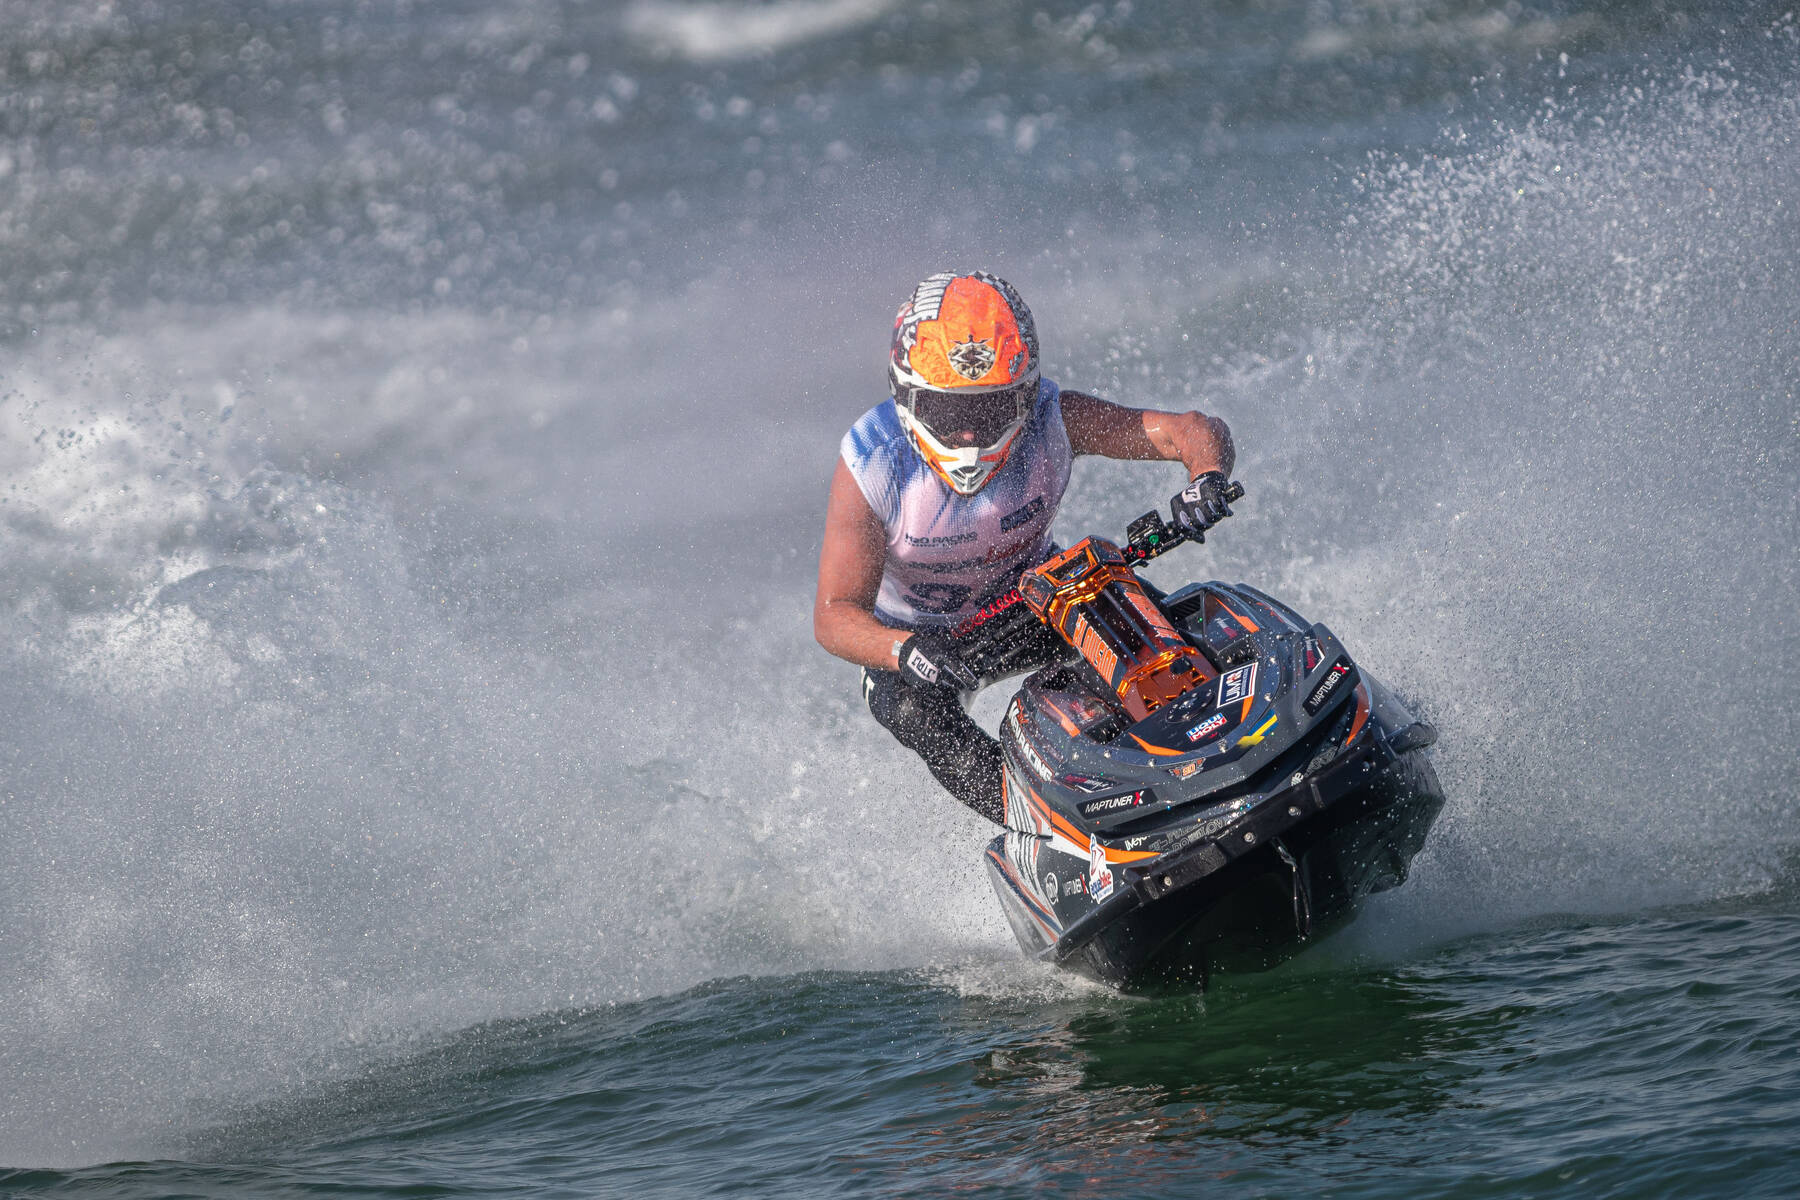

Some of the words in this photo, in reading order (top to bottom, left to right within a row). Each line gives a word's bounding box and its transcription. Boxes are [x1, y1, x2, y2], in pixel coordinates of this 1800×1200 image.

[932, 531, 978, 545] RACING
[1309, 671, 1342, 706] MAPTUNER
[1333, 662, 1350, 675] X
[1192, 718, 1223, 740] MOLY
[1085, 794, 1133, 813] MAPTUNER
[1133, 790, 1145, 806] X
